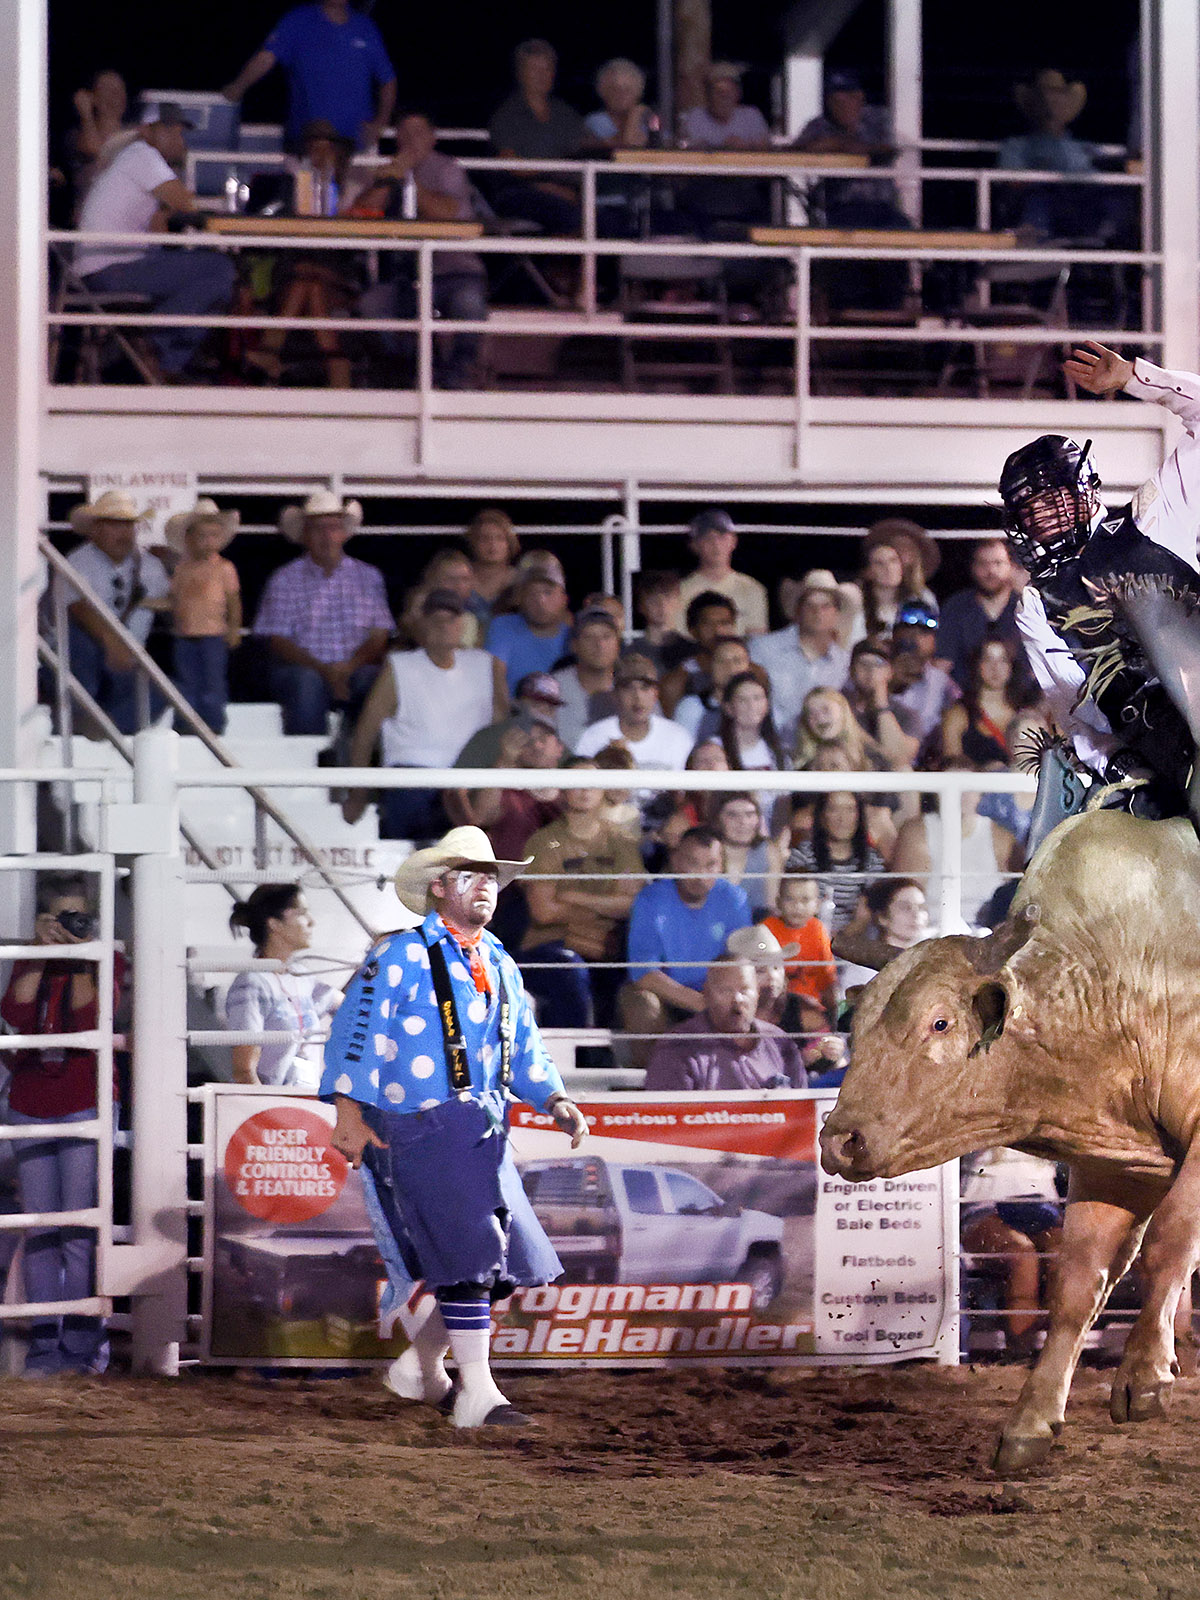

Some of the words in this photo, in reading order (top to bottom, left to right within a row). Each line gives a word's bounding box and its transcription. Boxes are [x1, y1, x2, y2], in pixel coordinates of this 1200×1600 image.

[519, 1111, 554, 1126] For
[603, 1111, 677, 1126] serious
[683, 1110, 786, 1125] cattlemen
[262, 1128, 308, 1145] USER
[245, 1145, 326, 1162] FRIENDLY
[240, 1163, 331, 1180] CONTROLS
[236, 1180, 249, 1196] &
[254, 1180, 337, 1197] FEATURES
[823, 1181, 878, 1195] Engine
[884, 1180, 938, 1192] Driven
[834, 1202, 850, 1212] or
[857, 1199, 923, 1212] Electric
[836, 1218, 874, 1230] Bale
[879, 1217, 922, 1230] Beds
[842, 1255, 917, 1267] Flatbeds
[490, 1284, 754, 1321] rogmann
[821, 1292, 888, 1305] Custom
[894, 1291, 938, 1304] Beds
[490, 1317, 811, 1354] aleHandler
[833, 1329, 869, 1342] Tool
[875, 1329, 924, 1342] Boxes
